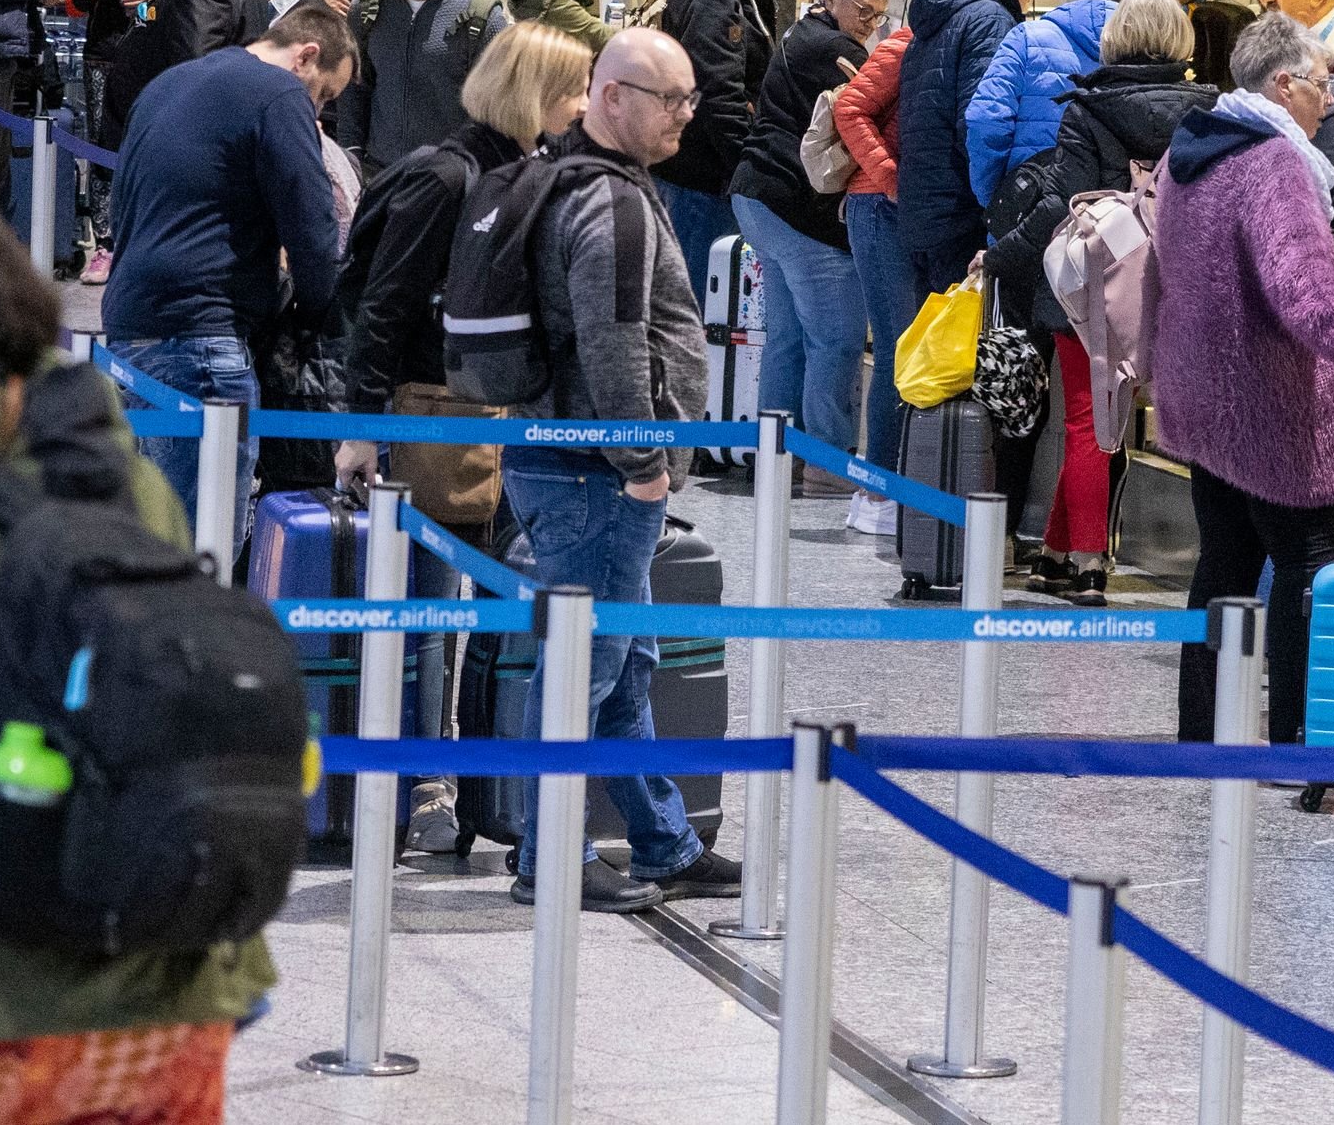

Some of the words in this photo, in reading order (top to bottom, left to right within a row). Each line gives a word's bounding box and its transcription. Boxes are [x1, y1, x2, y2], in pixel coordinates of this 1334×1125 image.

[525, 424, 675, 444] discover.airlines
[288, 605, 478, 629] discover.airlines
[973, 614, 1156, 637] discover.airlines
